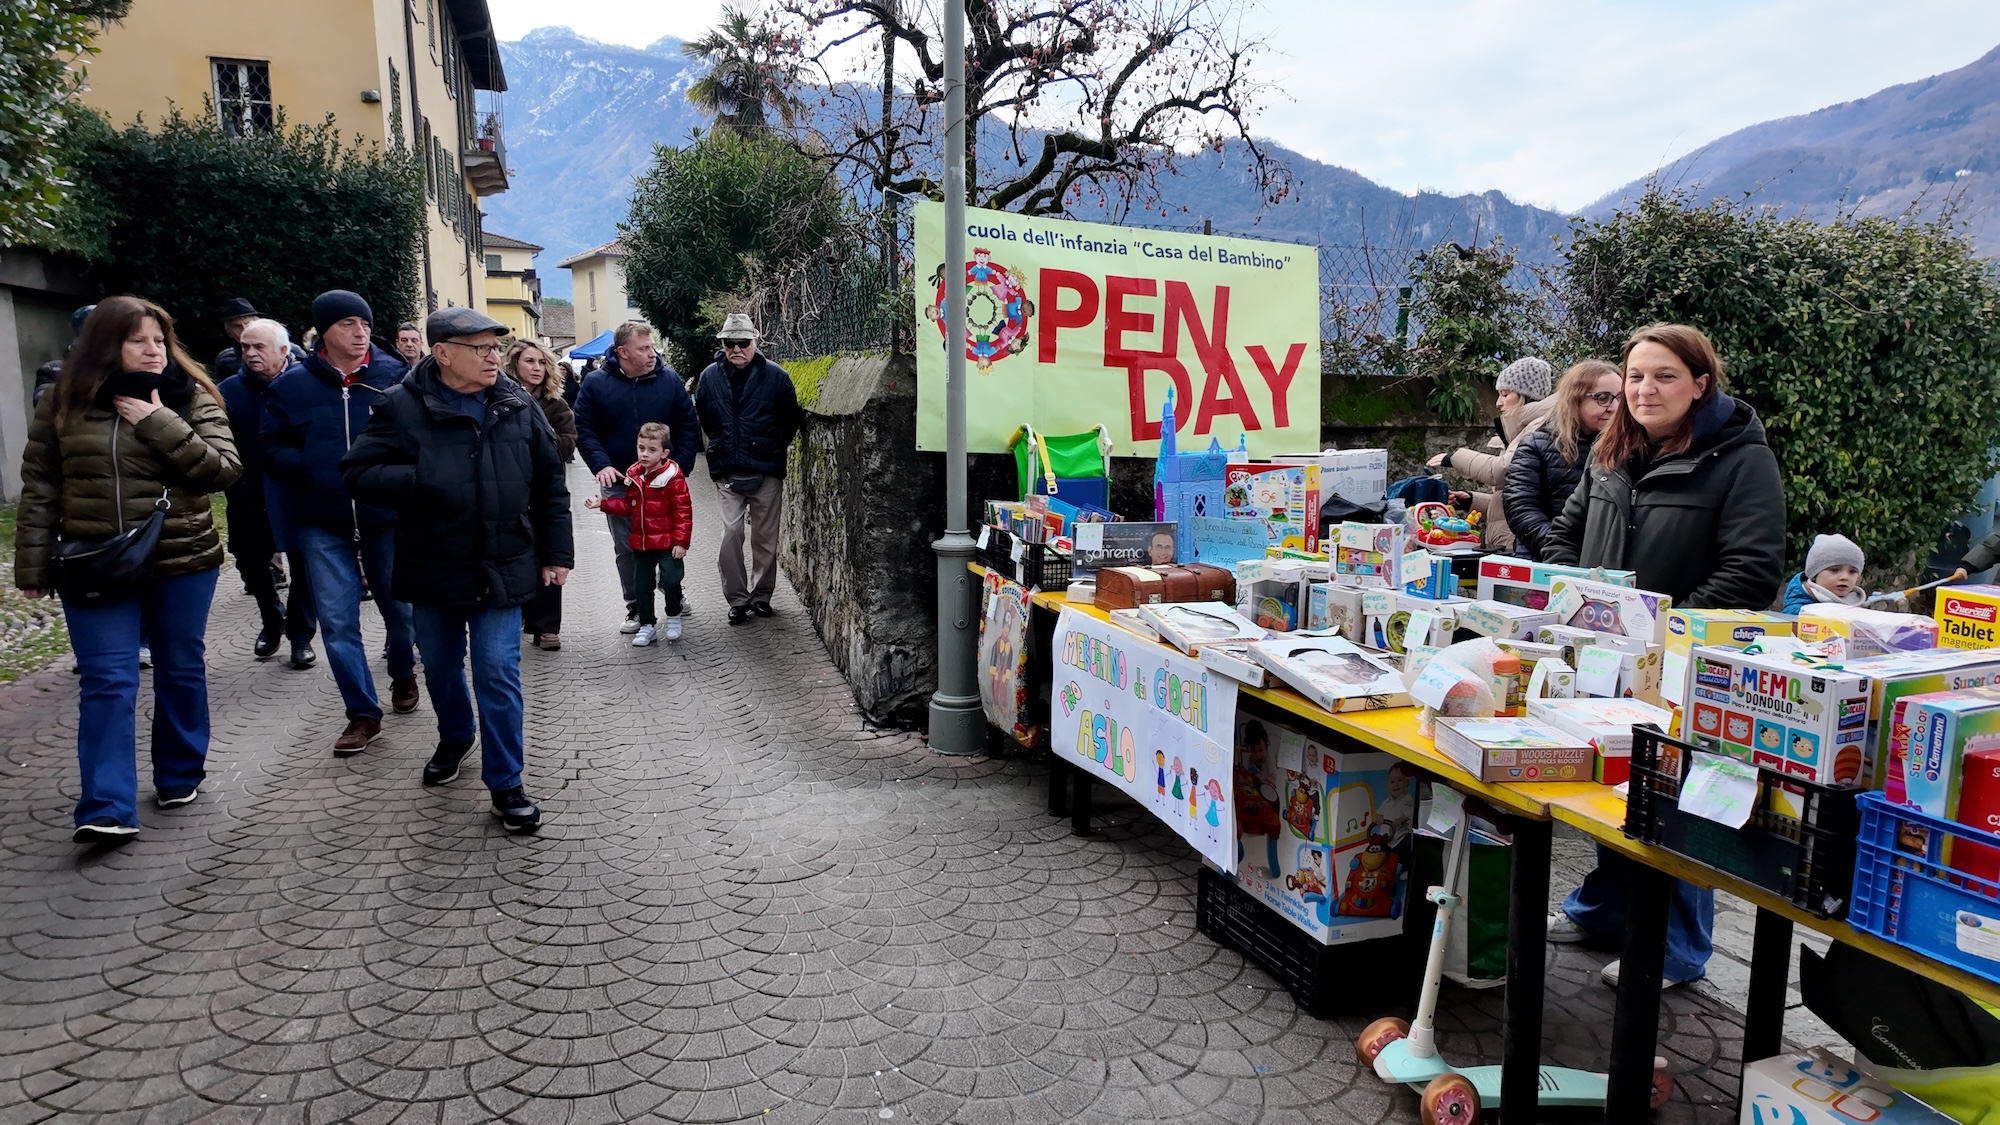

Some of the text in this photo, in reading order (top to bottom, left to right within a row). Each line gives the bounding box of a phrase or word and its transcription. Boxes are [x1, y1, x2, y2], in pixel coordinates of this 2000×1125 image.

[965, 223, 1017, 242] cuola
[1023, 230, 1128, 255] dell'infanzia
[1188, 247, 1213, 263] del
[1128, 343, 1308, 442] DAY
[1230, 472, 1251, 484] Bing
[1584, 586, 1601, 596] Forest
[1469, 604, 1504, 626] OFFERTA
[1947, 599, 1994, 620] Quercetti
[1943, 618, 1995, 642] Tablet
[1134, 667, 1147, 700] dei
[1742, 667, 1801, 702] MEMO
[1060, 680, 1082, 717] PRO
[1746, 692, 1793, 714] DONDOLO
[1521, 750, 1552, 759] WOODS
[1553, 749, 1585, 759] PUZZLE
[1928, 716, 1945, 769] Clementoni
[1327, 759, 1335, 769] 12
[1264, 891, 1319, 933] Horse Table Walker
[1265, 881, 1269, 889] 3
[1270, 884, 1276, 893] in
[1280, 889, 1309, 916] Twinkling
